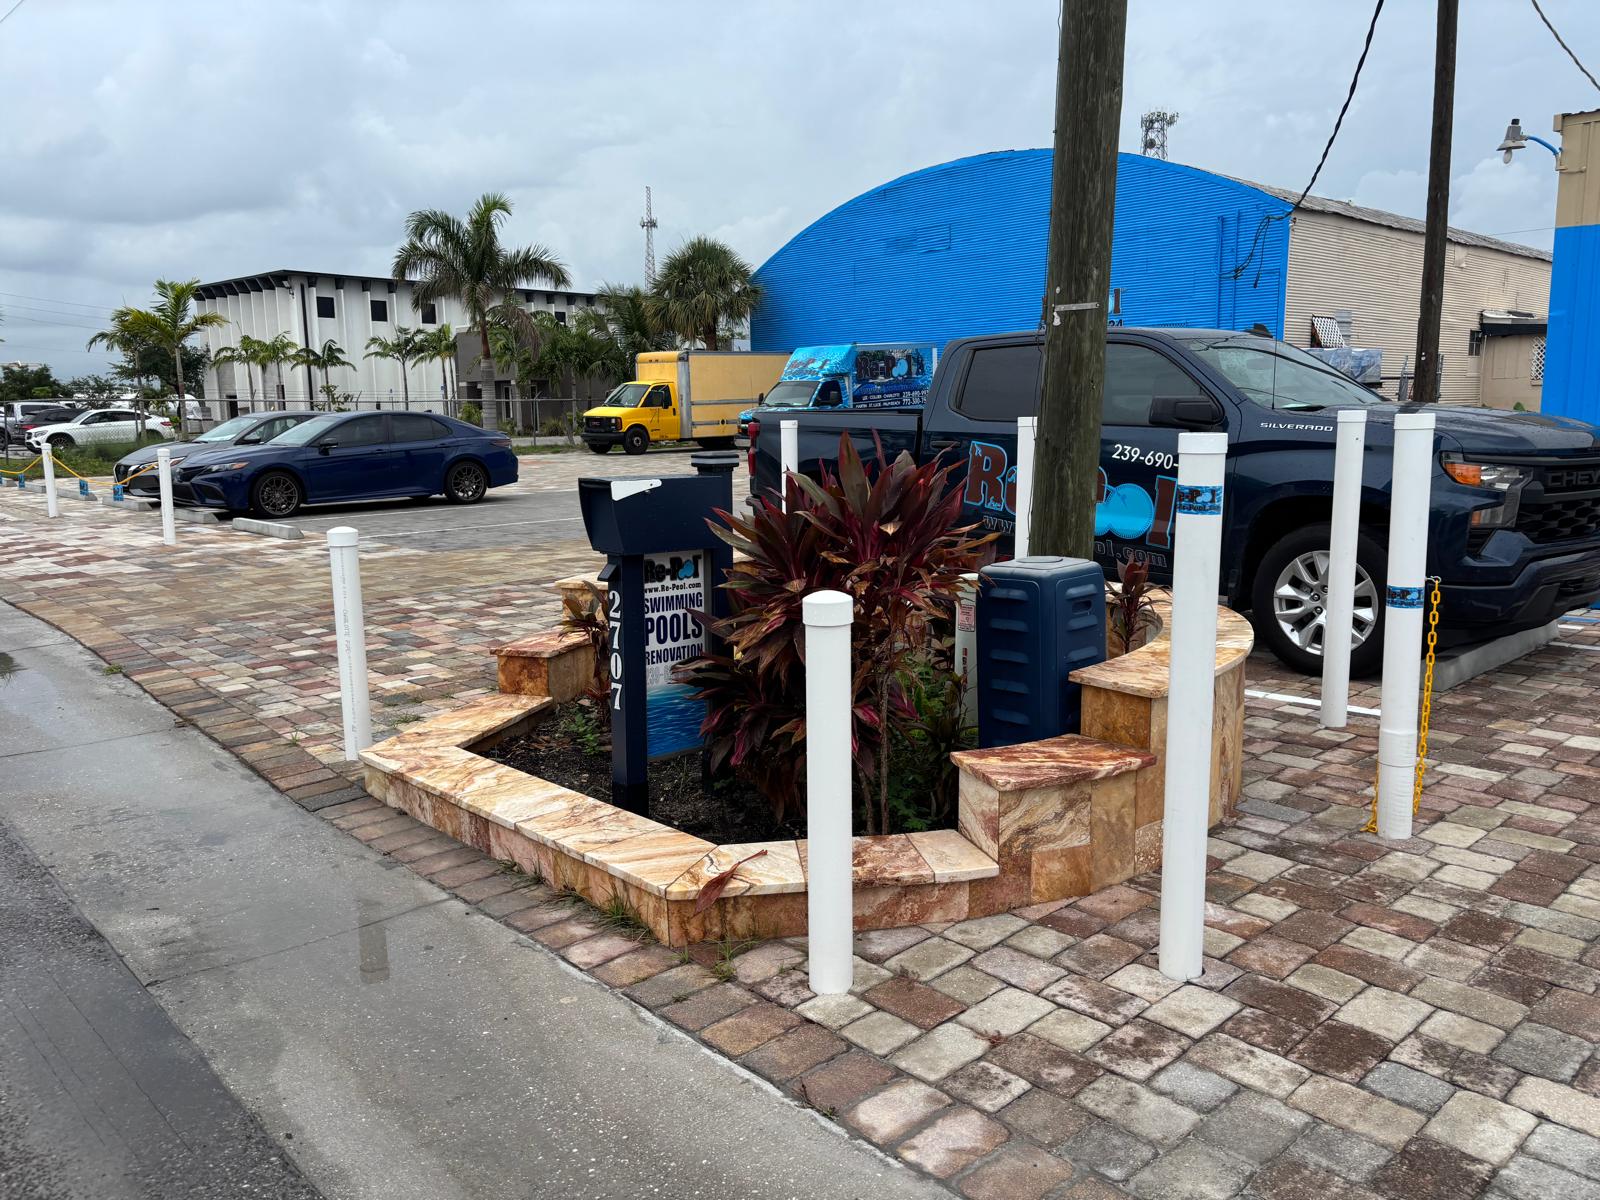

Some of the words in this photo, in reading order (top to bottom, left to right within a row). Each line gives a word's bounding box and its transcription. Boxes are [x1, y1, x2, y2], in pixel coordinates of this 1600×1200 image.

[1260, 422, 1334, 432] SILVERADO
[1111, 443, 1179, 470] 239-690-
[644, 591, 703, 615] SWIMMING
[644, 612, 703, 647] POOLS
[608, 590, 623, 710] 2707
[645, 643, 703, 666] RENOVATION
